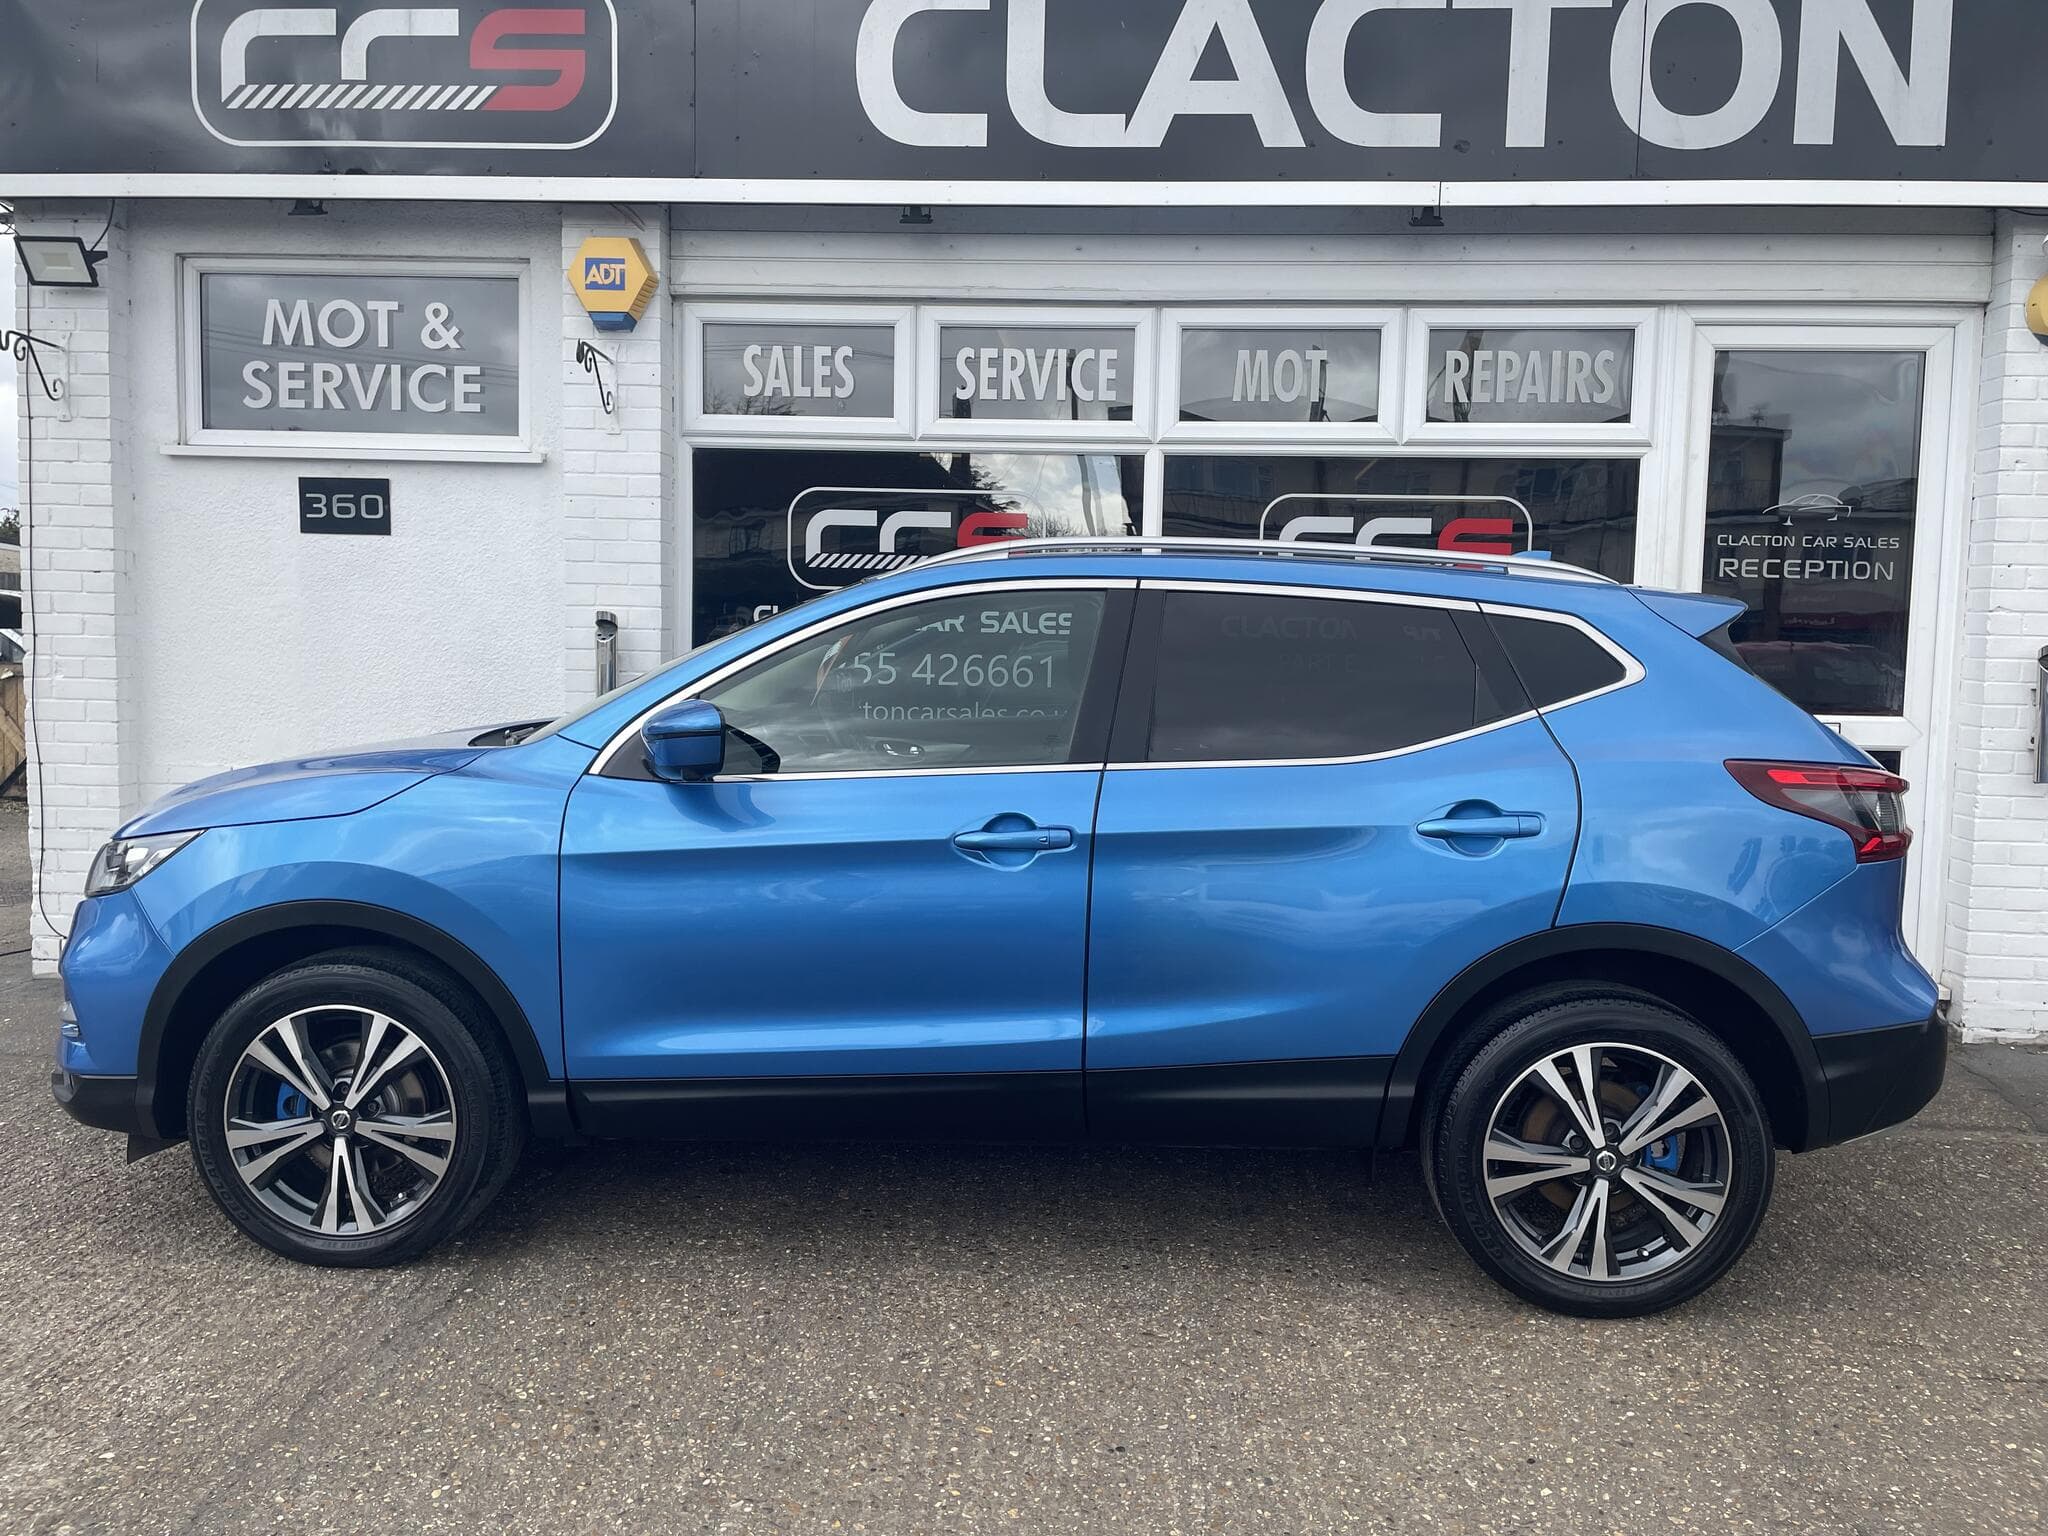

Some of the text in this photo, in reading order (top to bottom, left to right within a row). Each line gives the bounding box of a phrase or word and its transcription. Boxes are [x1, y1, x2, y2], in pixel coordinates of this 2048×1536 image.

[856, 0, 1953, 149] CLACTON
[585, 264, 626, 285] ADT
[262, 300, 464, 351] MOT &
[242, 361, 483, 412] SERVICE
[743, 344, 855, 399] SALES
[955, 347, 1118, 402] SERVICE
[1233, 349, 1328, 403] MOT
[1444, 349, 1616, 405] REPAIRS
[305, 492, 384, 520] 360
[1717, 534, 1900, 549] CLACTON CAR SALES
[1718, 558, 1895, 581] RECEPTION
[980, 611, 1073, 635] SALES
[911, 653, 1054, 689] 426661
